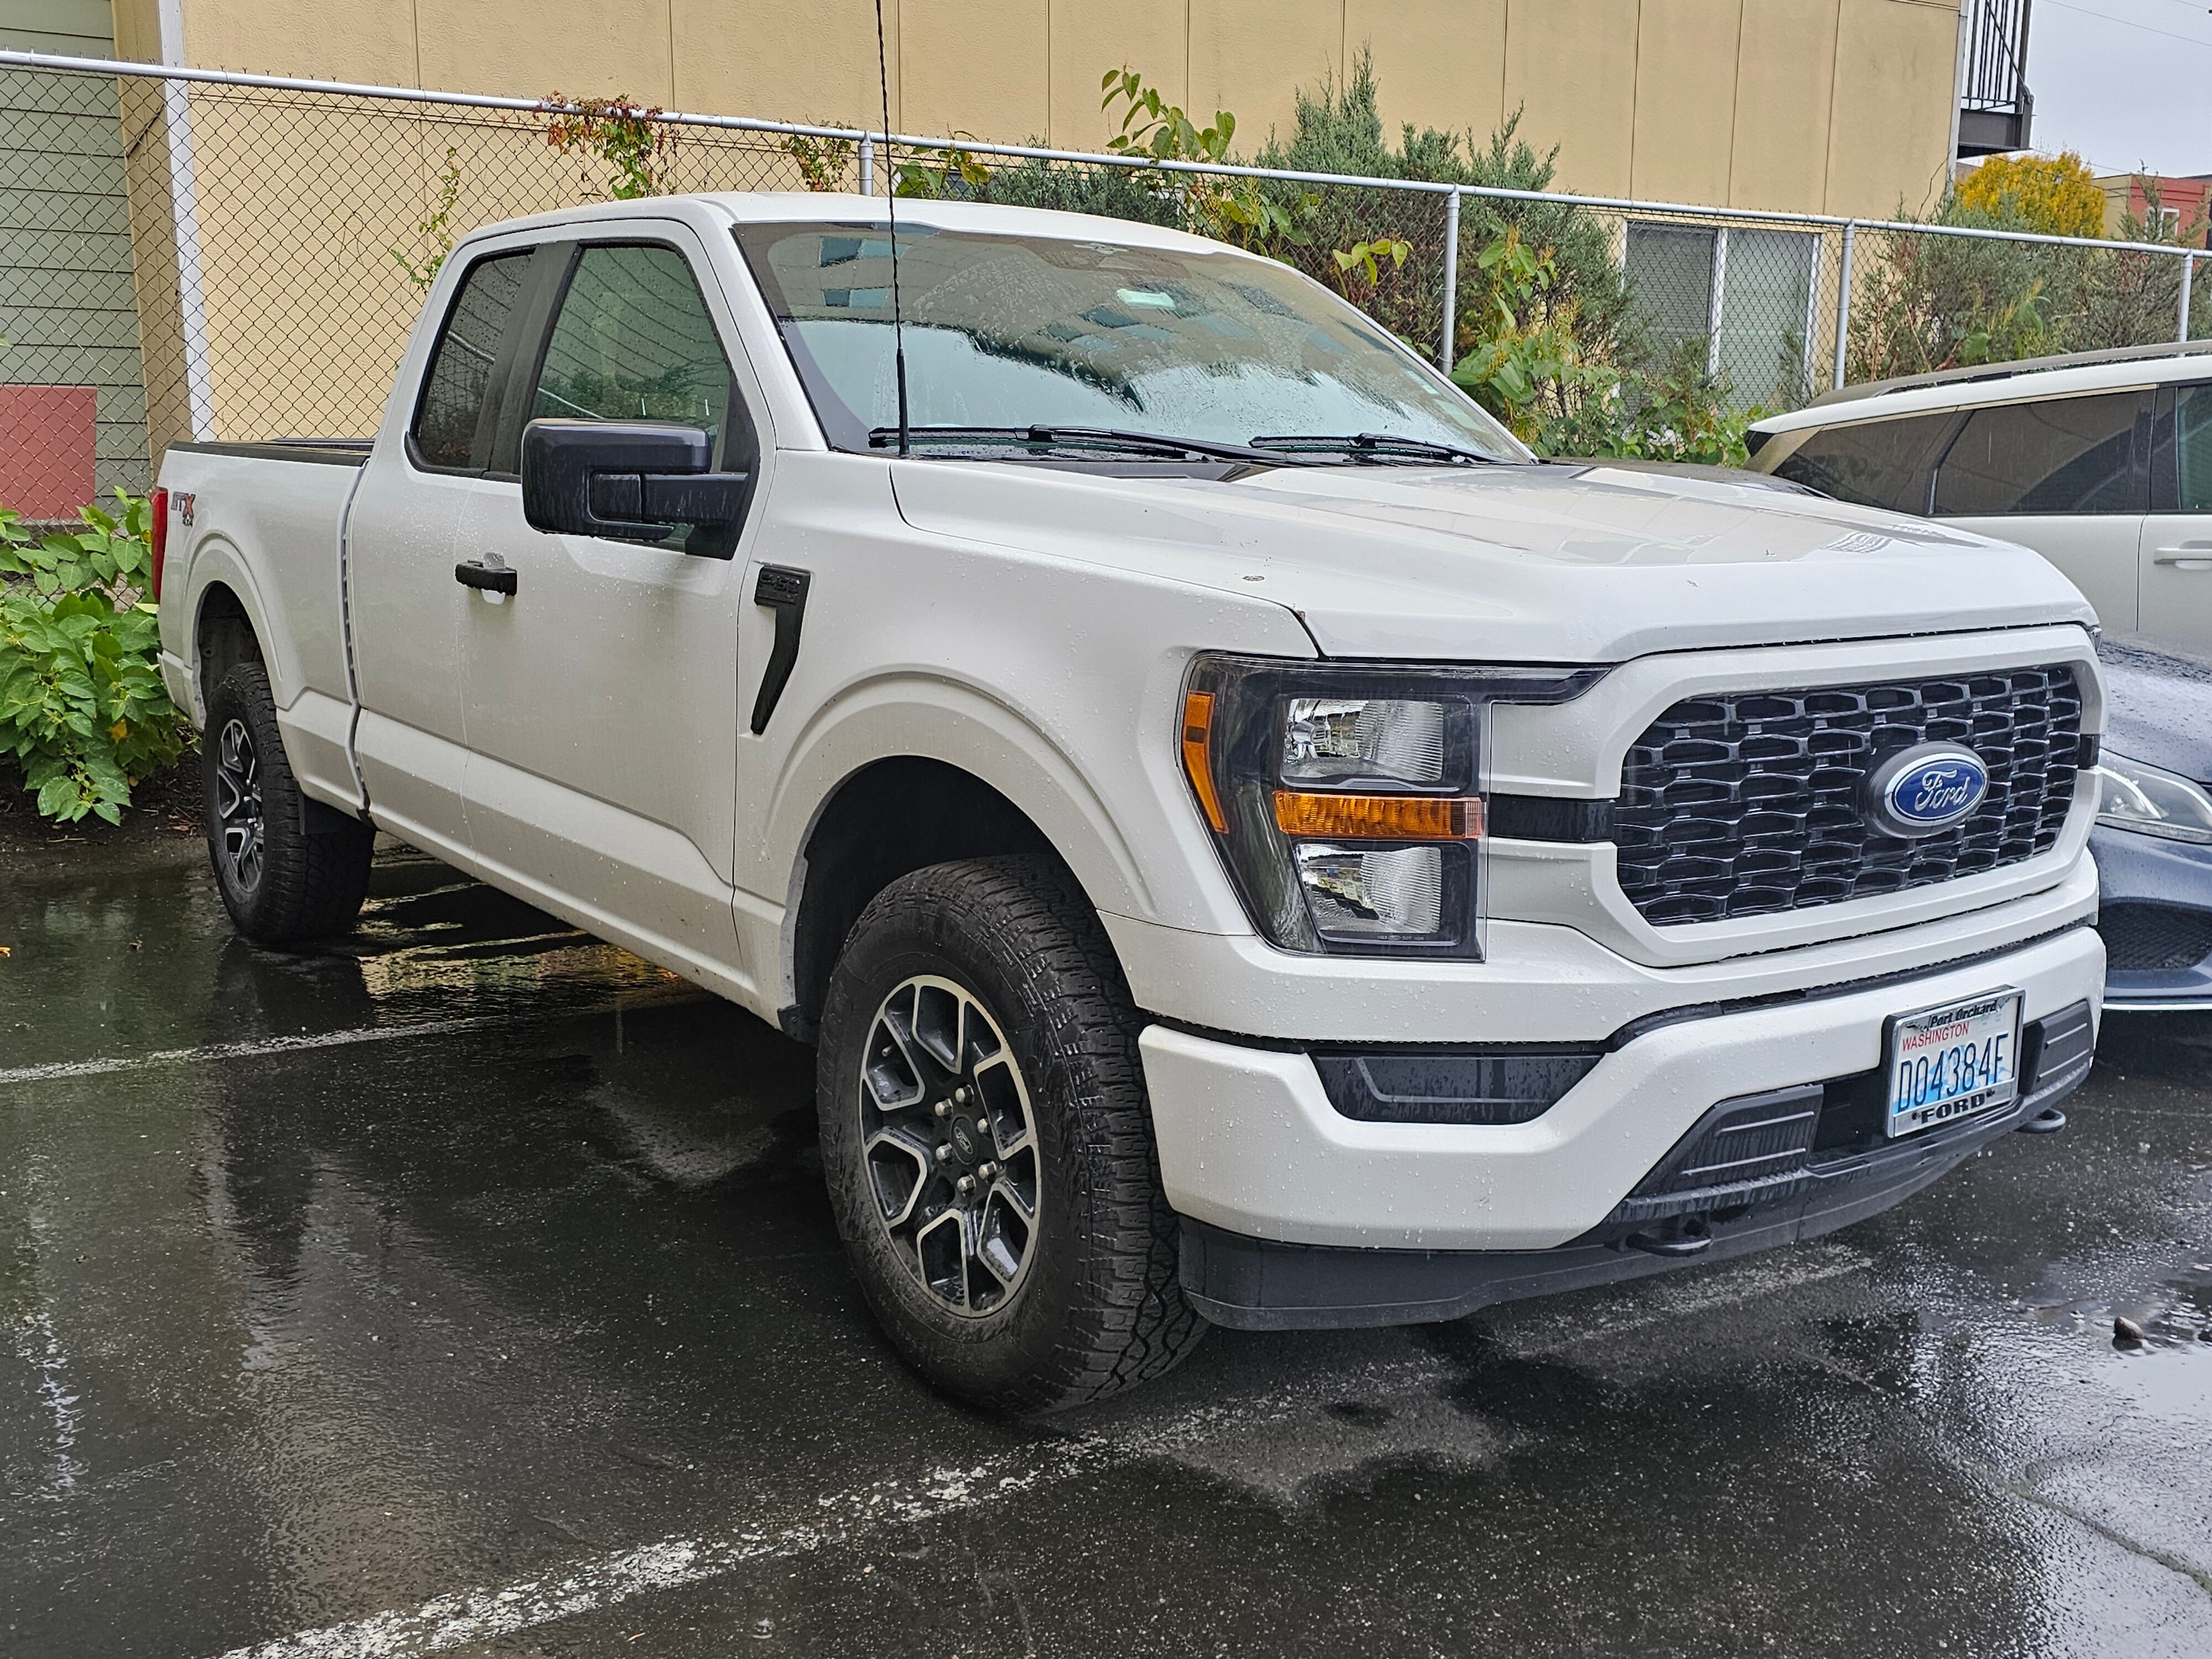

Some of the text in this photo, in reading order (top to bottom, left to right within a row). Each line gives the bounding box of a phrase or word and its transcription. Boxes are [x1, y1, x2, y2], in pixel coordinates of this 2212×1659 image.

[1914, 769, 1970, 811] Ford
[1929, 1011, 1953, 1029] Port
[1956, 999, 1998, 1020] Orchard
[1902, 1021, 1970, 1052] WASHINGTON
[1898, 1032, 2009, 1113] D04384F
[1921, 1093, 1985, 1124] FORD
